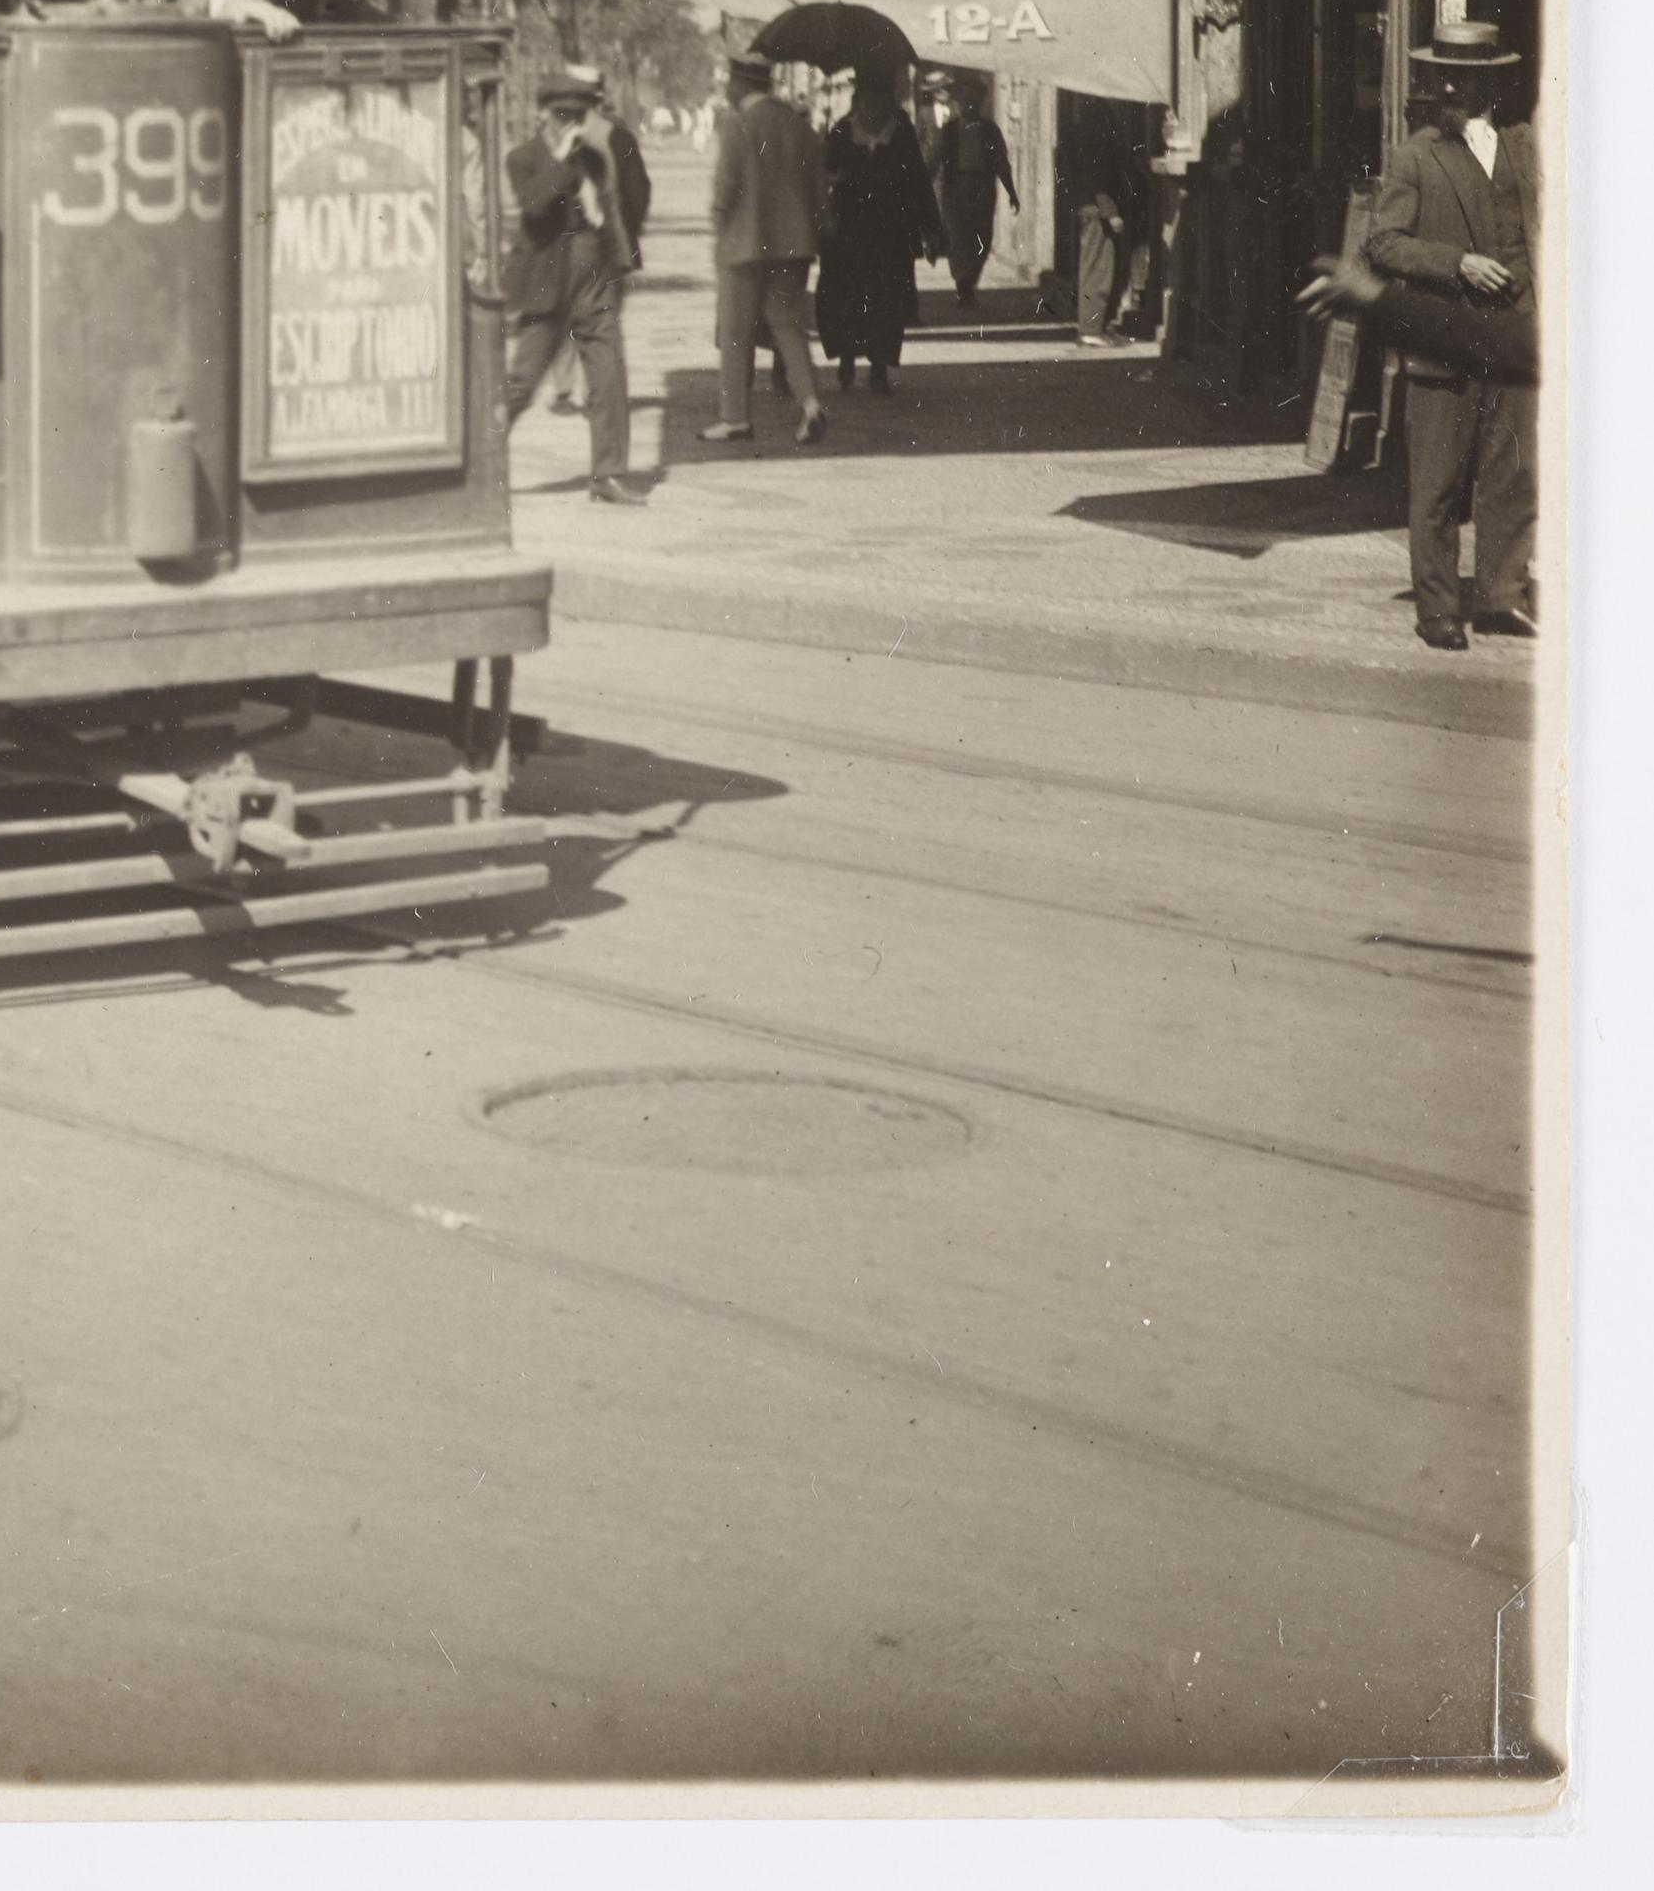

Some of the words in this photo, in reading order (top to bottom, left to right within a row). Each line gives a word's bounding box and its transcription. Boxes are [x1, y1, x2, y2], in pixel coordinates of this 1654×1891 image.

[929, 0, 1055, 44] 12-A
[44, 106, 227, 226] 399
[270, 189, 438, 275] MOVEIS
